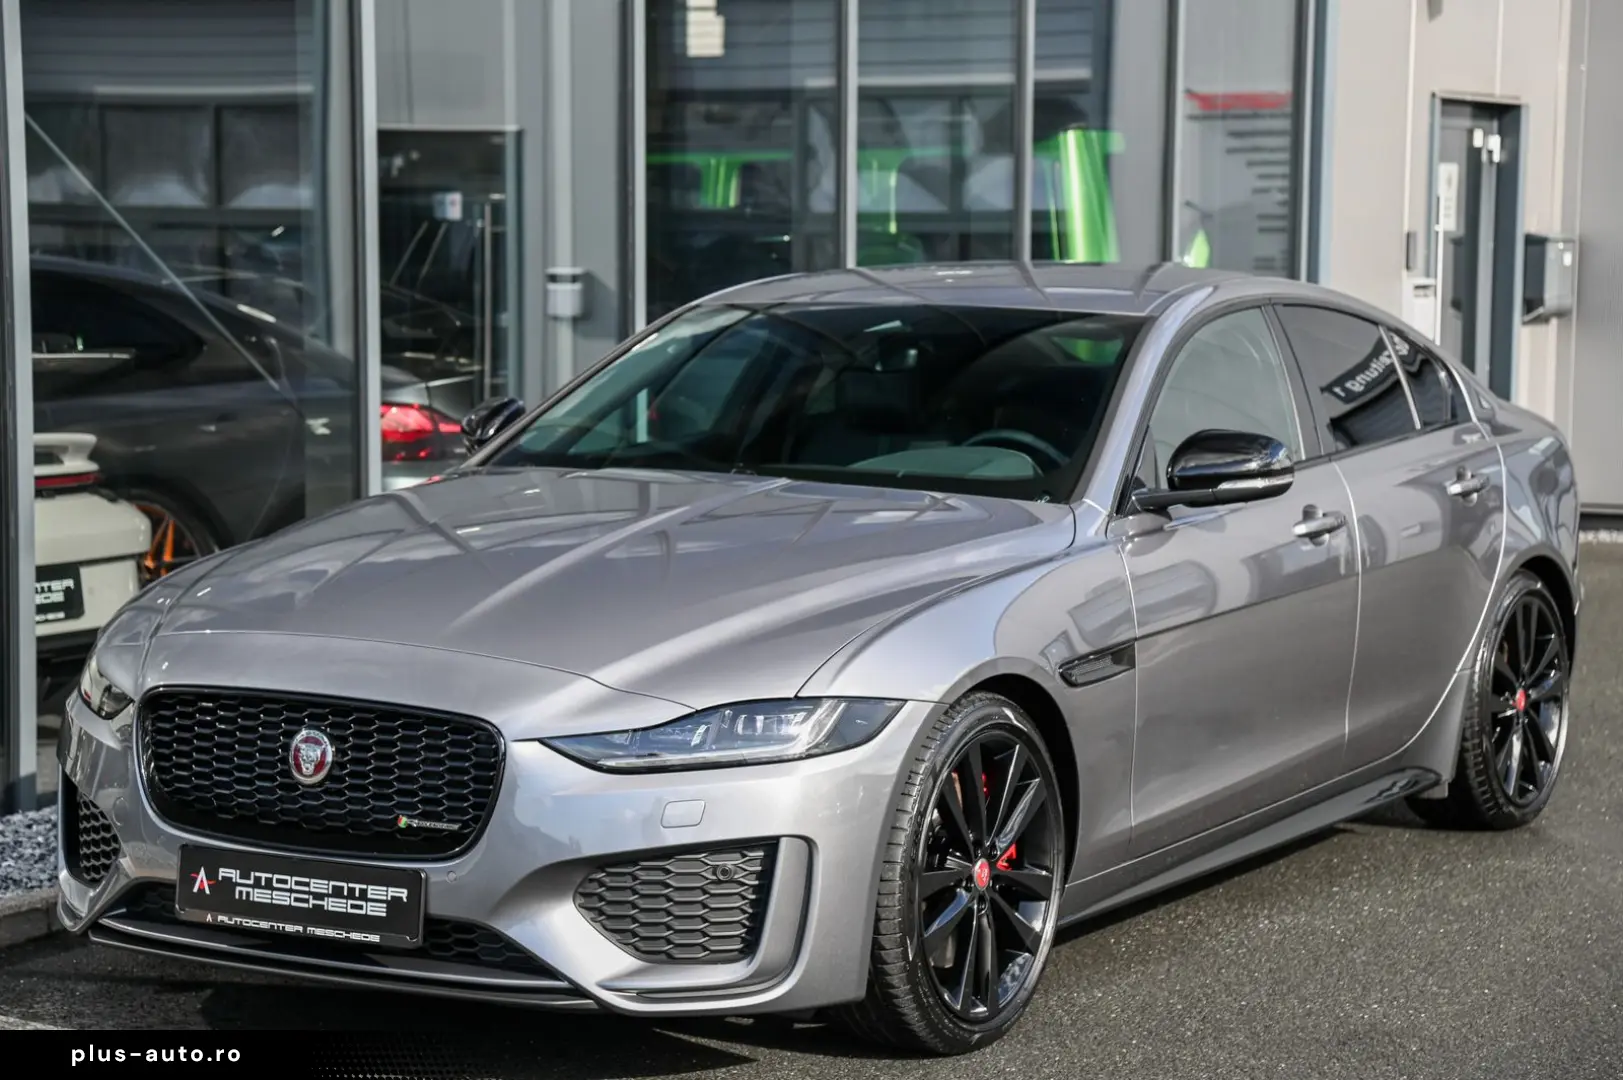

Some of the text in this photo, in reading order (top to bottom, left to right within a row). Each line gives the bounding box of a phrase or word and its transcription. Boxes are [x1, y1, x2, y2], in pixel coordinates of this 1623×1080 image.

[218, 867, 408, 902] AUTOCENTER
[235, 886, 387, 917] MESCHEDE
[217, 915, 303, 933] AUTOCENTER
[307, 926, 380, 942] MESCHEDE
